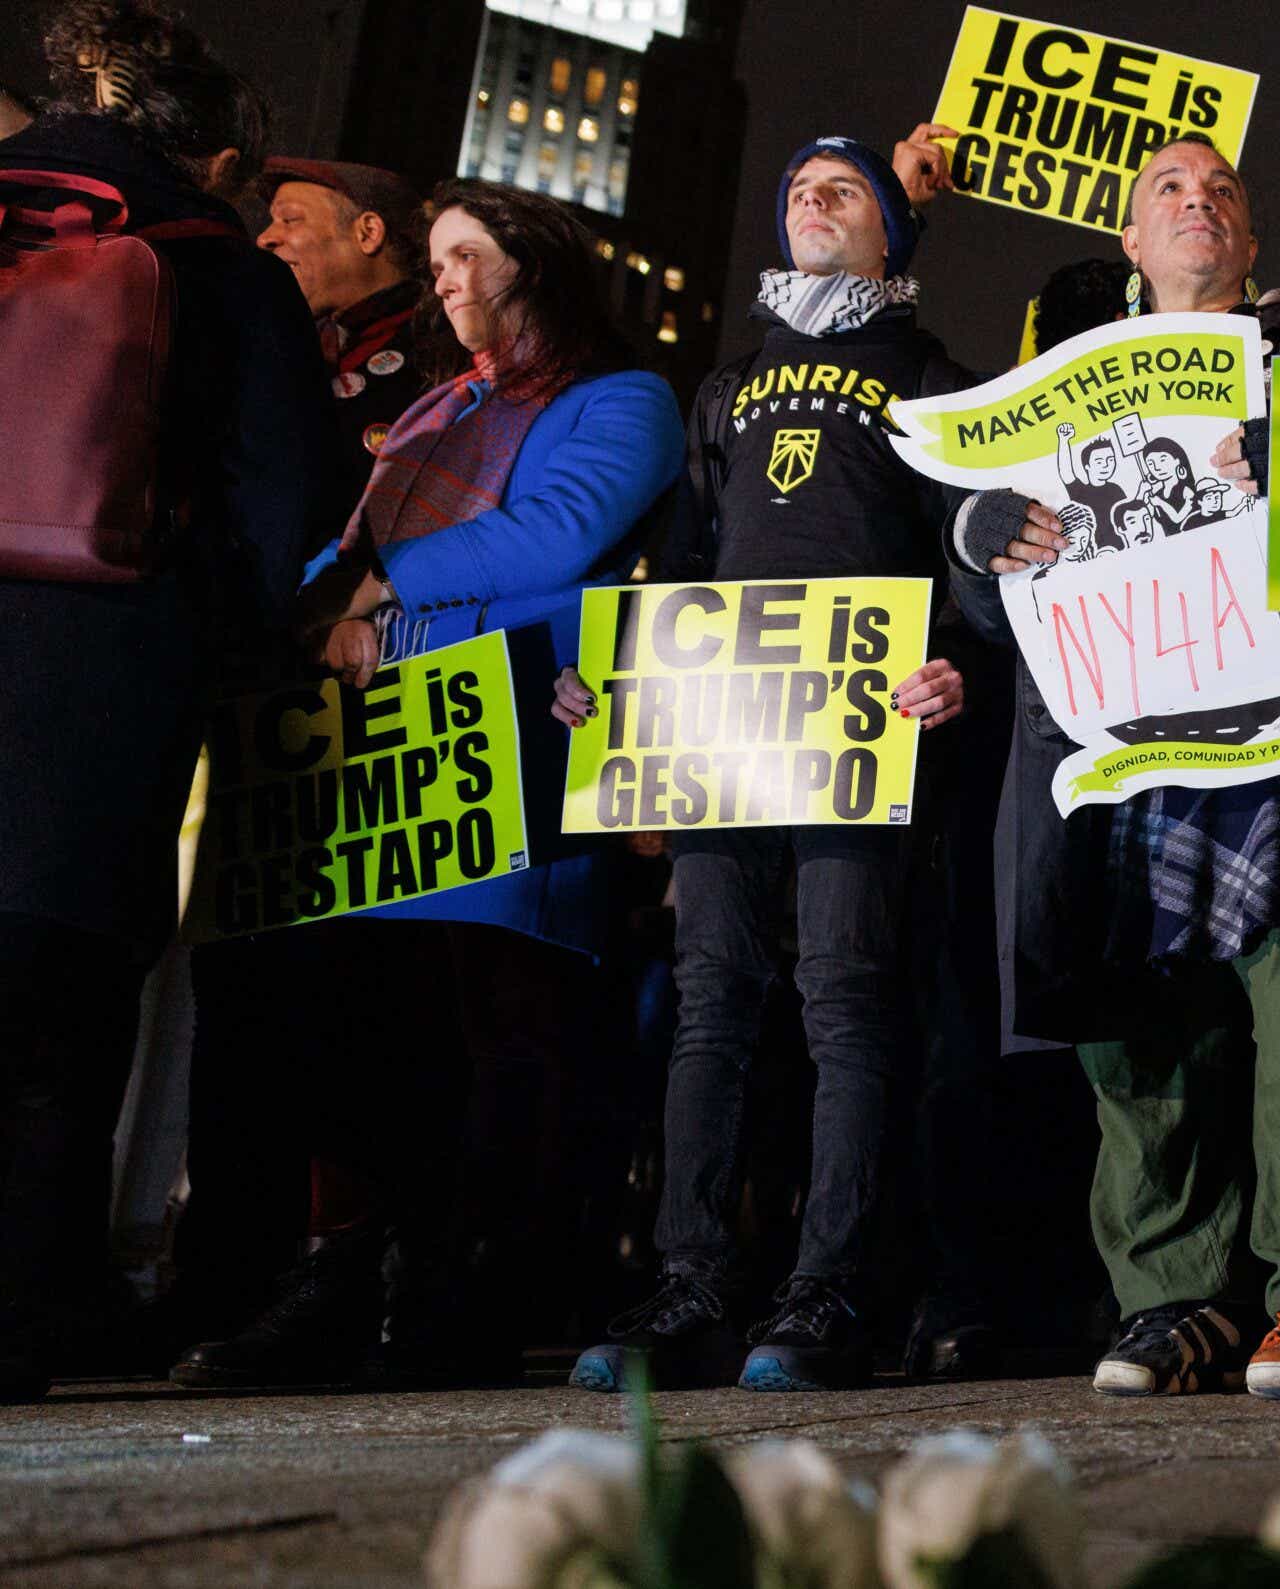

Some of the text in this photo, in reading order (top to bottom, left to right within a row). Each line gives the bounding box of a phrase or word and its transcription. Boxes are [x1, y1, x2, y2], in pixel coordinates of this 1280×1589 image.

[983, 18, 1222, 129] ICE is
[967, 78, 1211, 173] TRUMP'
[951, 134, 1139, 232] GESTA
[733, 398, 889, 435] MOVEMEN
[957, 347, 1235, 448] MAKE THE ROAD
[1086, 380, 1235, 422] NEW YORK
[612, 584, 890, 672] ICE is
[426, 668, 484, 736] is
[602, 669, 888, 750] TRUMP'S
[596, 747, 878, 828] GESTAPO
[1102, 750, 1170, 777] DIGNIDAD,
[1174, 750, 1255, 762] COMUNIDAD
[1258, 747, 1268, 757] Y
